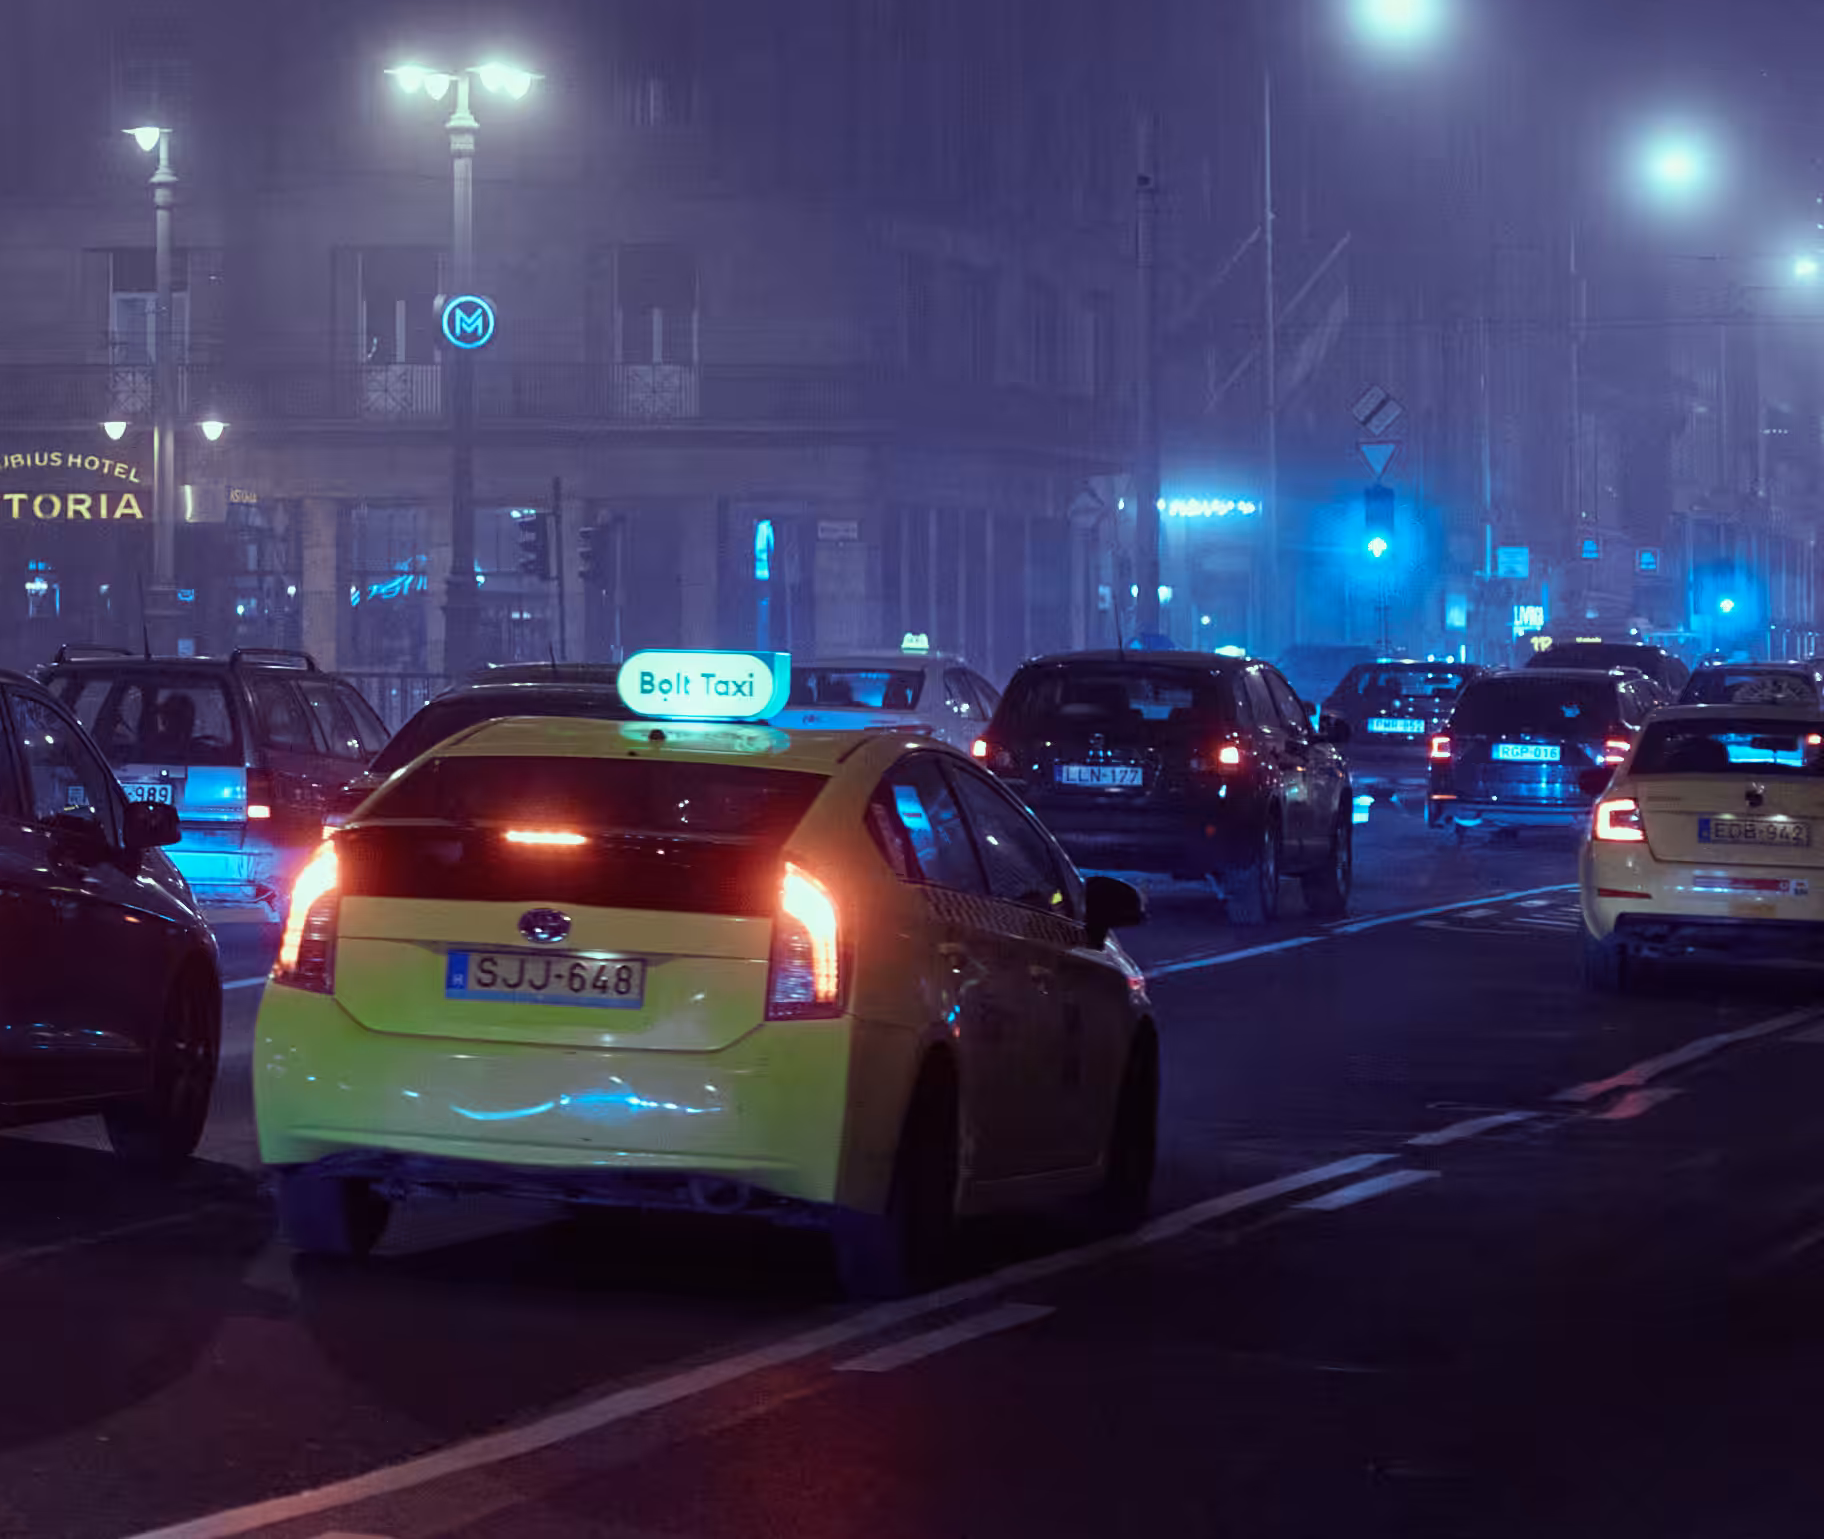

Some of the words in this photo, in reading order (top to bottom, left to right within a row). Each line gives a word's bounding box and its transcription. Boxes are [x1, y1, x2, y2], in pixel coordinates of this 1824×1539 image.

[68, 452, 141, 483] HOTEL
[640, 671, 691, 695] Bolt
[700, 672, 754, 697] Taxi
[1065, 766, 1140, 784] LLN-177
[475, 956, 633, 996] SJJ-648
